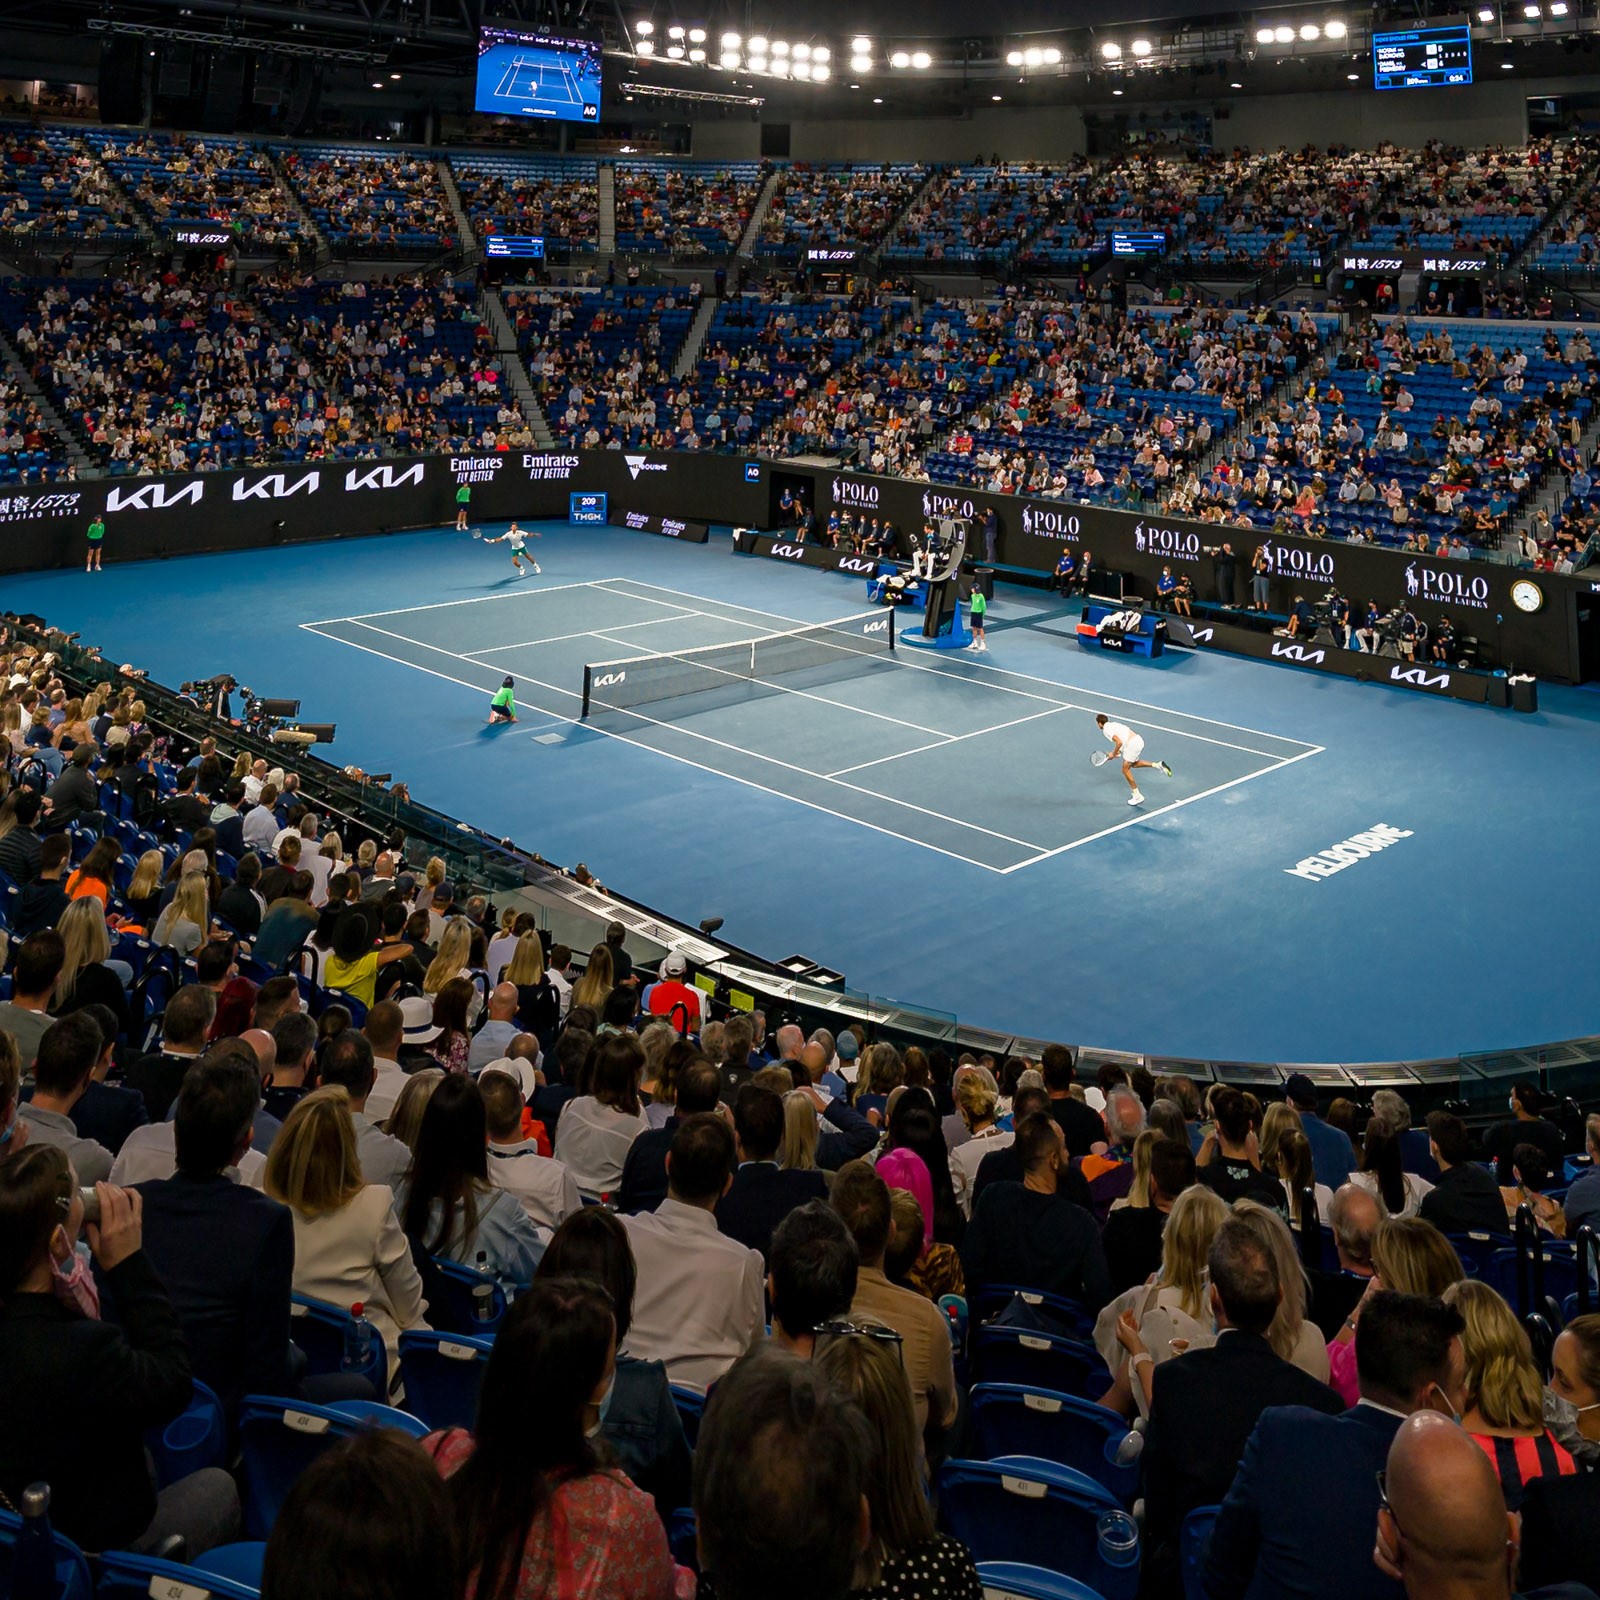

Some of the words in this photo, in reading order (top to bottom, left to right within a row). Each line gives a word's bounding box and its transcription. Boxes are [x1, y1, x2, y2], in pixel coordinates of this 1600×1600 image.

[538, 25, 550, 33] AO
[1413, 20, 1427, 28] AO
[584, 106, 597, 116] AO
[450, 457, 503, 472] Emirates
[522, 454, 579, 468] Emirates
[457, 471, 468, 484] FLY
[469, 470, 494, 482] BETTER
[530, 468, 542, 480] FLY
[543, 468, 570, 479] BETTER
[748, 468, 759, 476] AO
[842, 482, 879, 503] POLO
[582, 497, 596, 506] 209
[52, 508, 79, 517] 1573
[1034, 511, 1080, 535] POLO
[1148, 528, 1200, 554] POLO
[1148, 547, 1170, 557] RALPH
[1173, 551, 1200, 562] LAUREN
[1276, 546, 1335, 575] POLO
[1277, 568, 1301, 578] RALPH
[1304, 572, 1334, 583] LAUREN
[1422, 568, 1489, 600] POLO
[1424, 592, 1451, 604] RALPH
[1455, 597, 1488, 609] LAUREN
[1284, 822, 1415, 882] MELBOURNE
[298, 1416, 310, 1426] 434
[167, 1586, 184, 1599] 434
